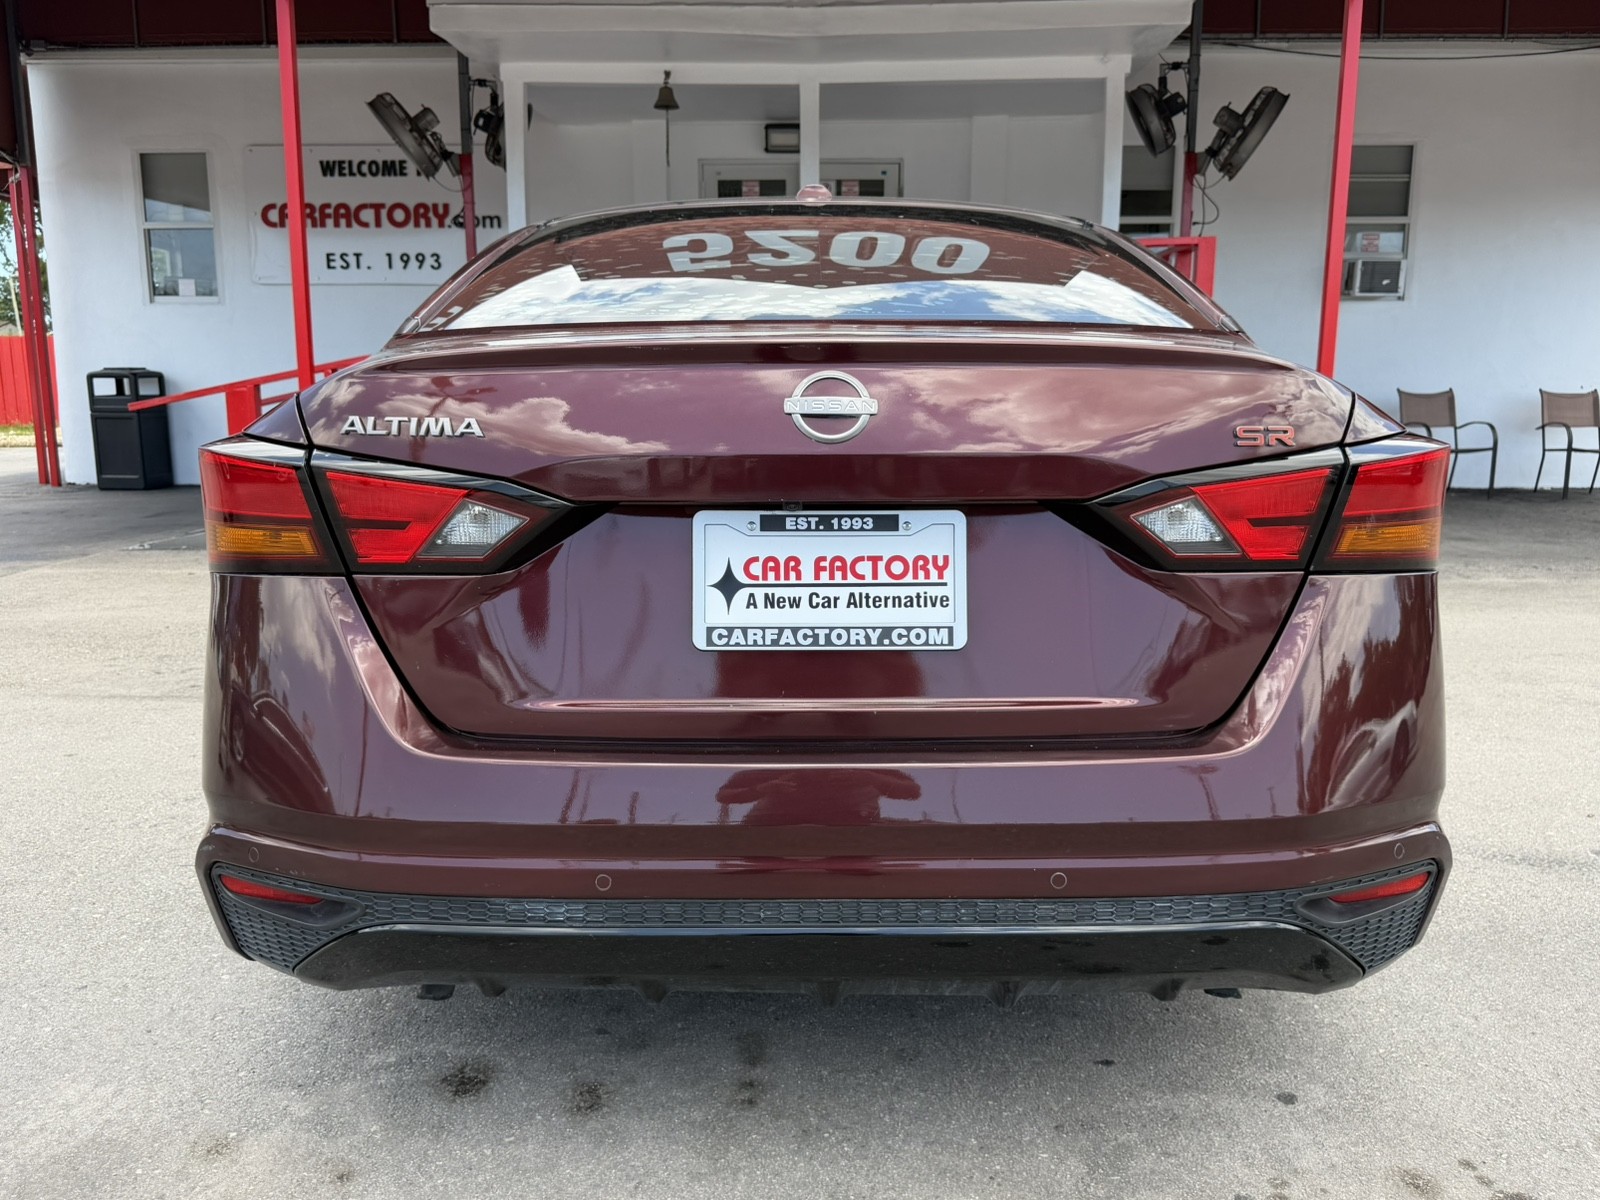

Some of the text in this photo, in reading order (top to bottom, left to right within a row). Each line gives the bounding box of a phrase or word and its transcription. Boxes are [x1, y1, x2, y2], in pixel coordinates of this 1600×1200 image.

[319, 160, 408, 177] WELCOME
[326, 252, 442, 270] EST. 1993
[786, 400, 876, 412] NISSAN
[340, 415, 485, 438] ALTIMA
[1234, 425, 1297, 447] SR
[785, 517, 874, 530] EST. 1993
[743, 555, 950, 581] CAR FACTORY
[745, 591, 950, 609] A New Car Alternative
[711, 628, 949, 646] CARFACTORY.COM
